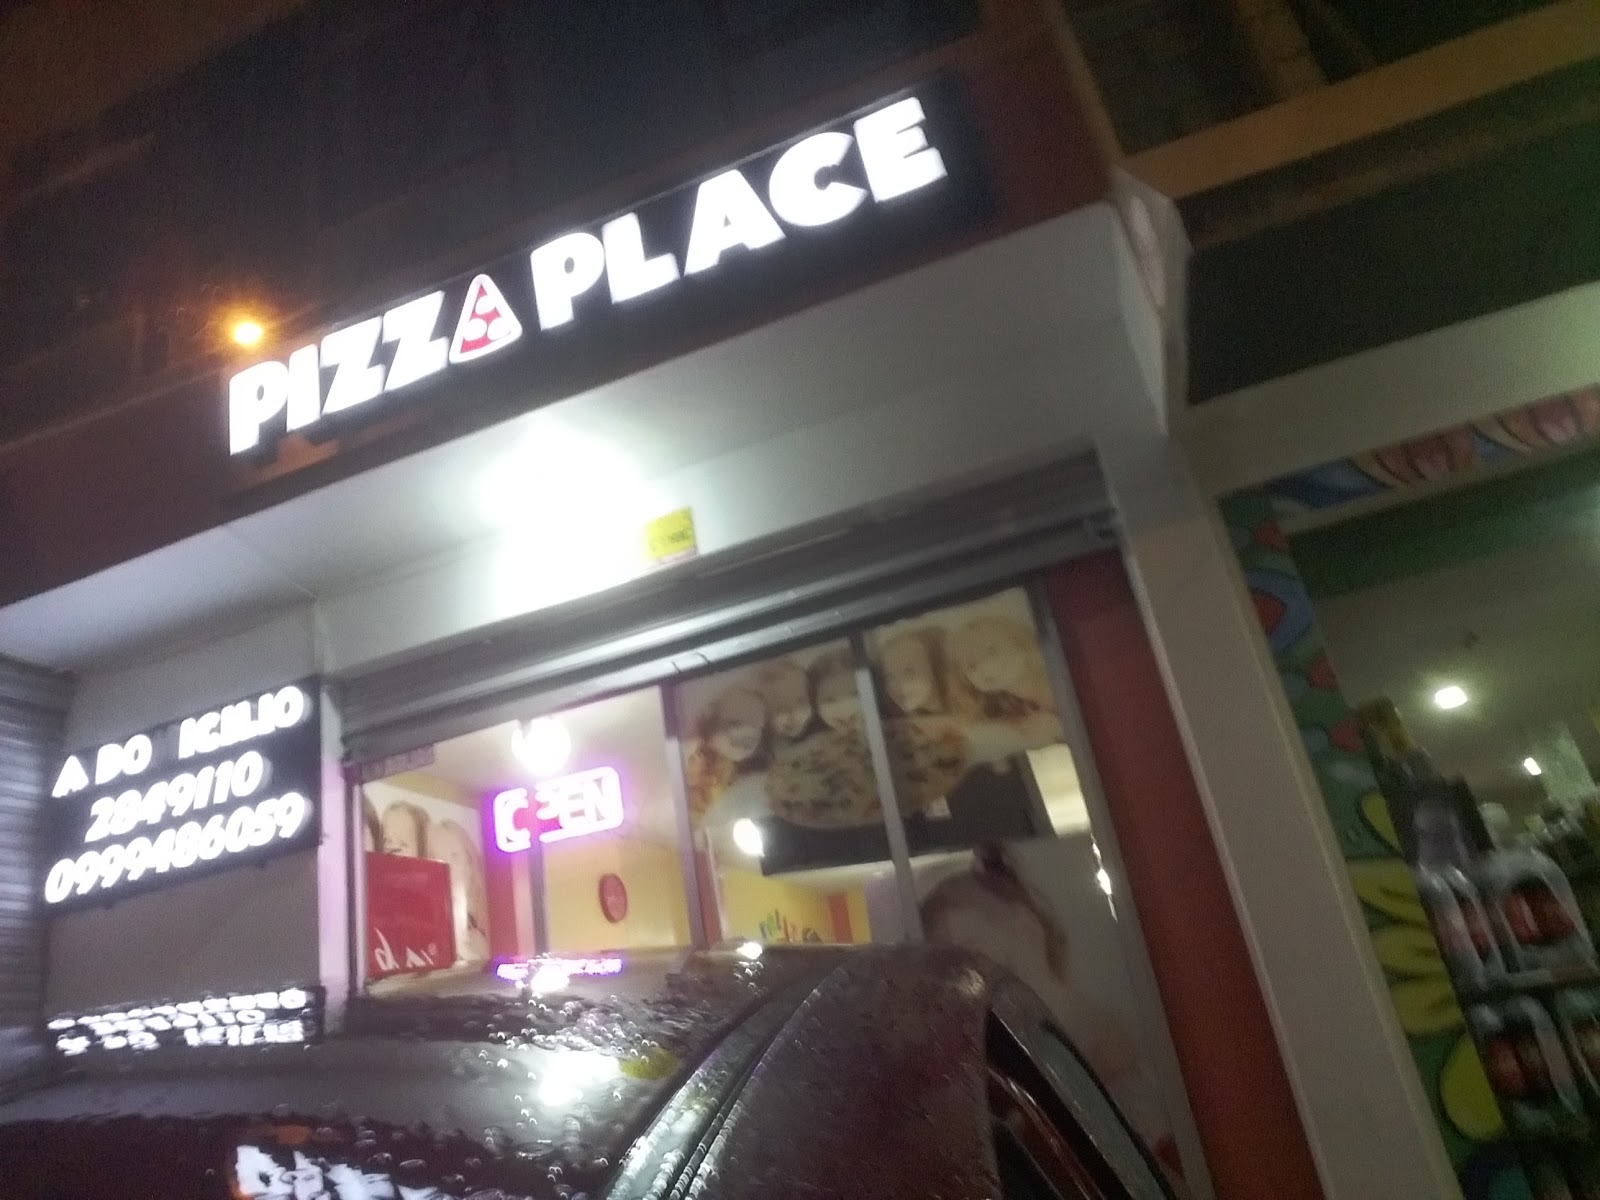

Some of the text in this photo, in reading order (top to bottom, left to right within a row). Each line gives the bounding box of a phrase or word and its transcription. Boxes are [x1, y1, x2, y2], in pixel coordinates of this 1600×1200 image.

[229, 96, 948, 456] PIZZA PLACE
[52, 754, 89, 798] A
[85, 750, 265, 842] 2849110
[45, 792, 307, 903] 0999486059
